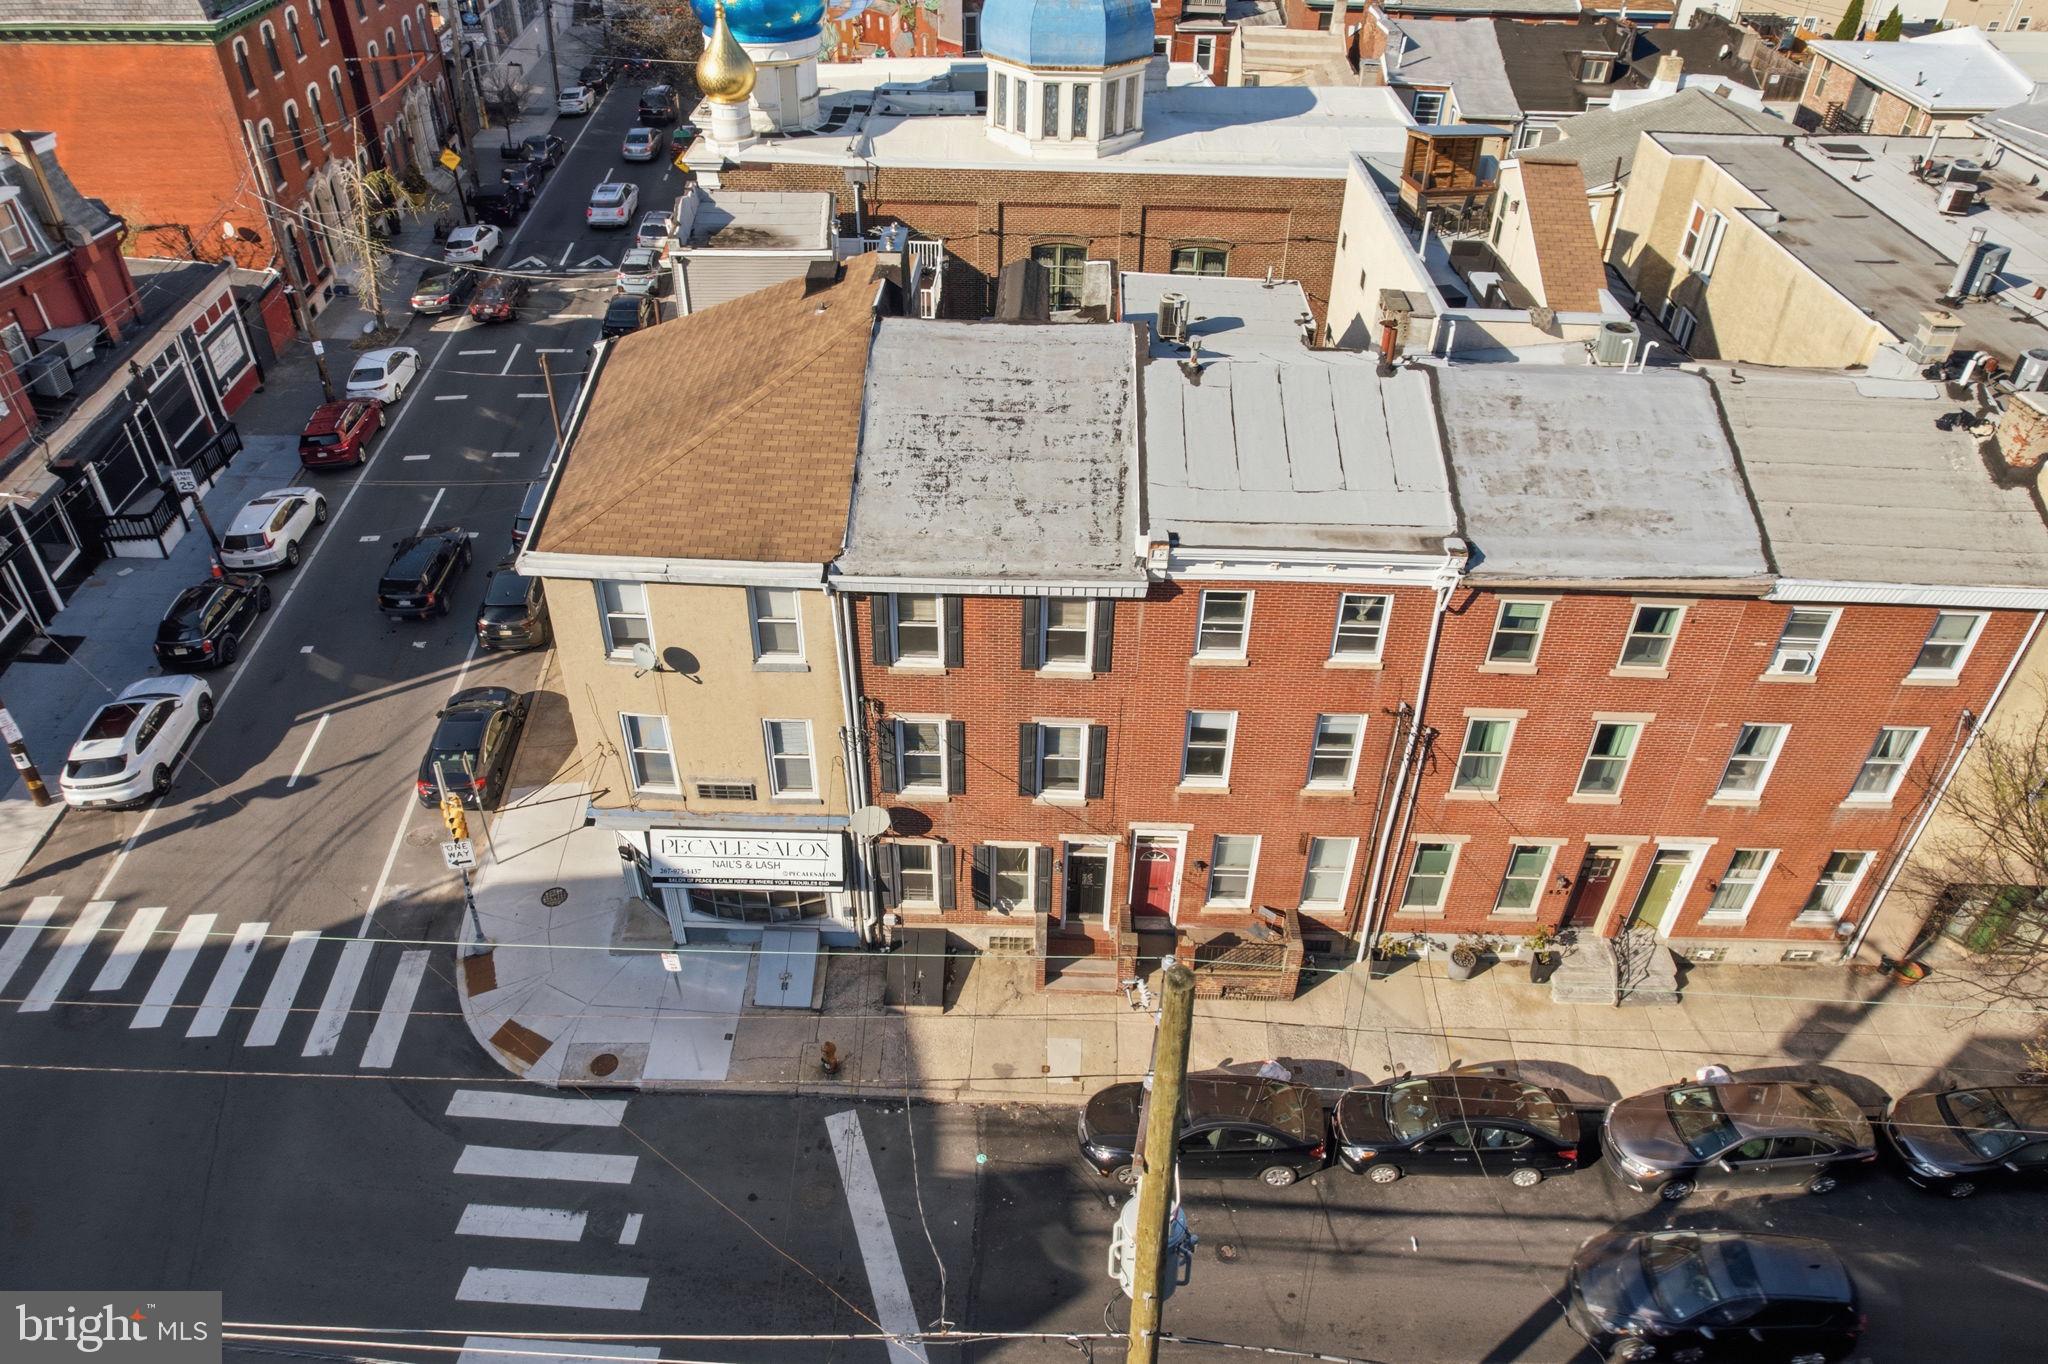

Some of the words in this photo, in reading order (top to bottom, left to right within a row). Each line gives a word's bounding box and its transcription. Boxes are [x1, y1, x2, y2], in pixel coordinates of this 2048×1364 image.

[179, 481, 195, 490] 25
[445, 843, 468, 851] ONE
[756, 841, 829, 857] SALON
[448, 850, 470, 858] WAY
[744, 861, 752, 869] &
[756, 861, 781, 869] LASH
